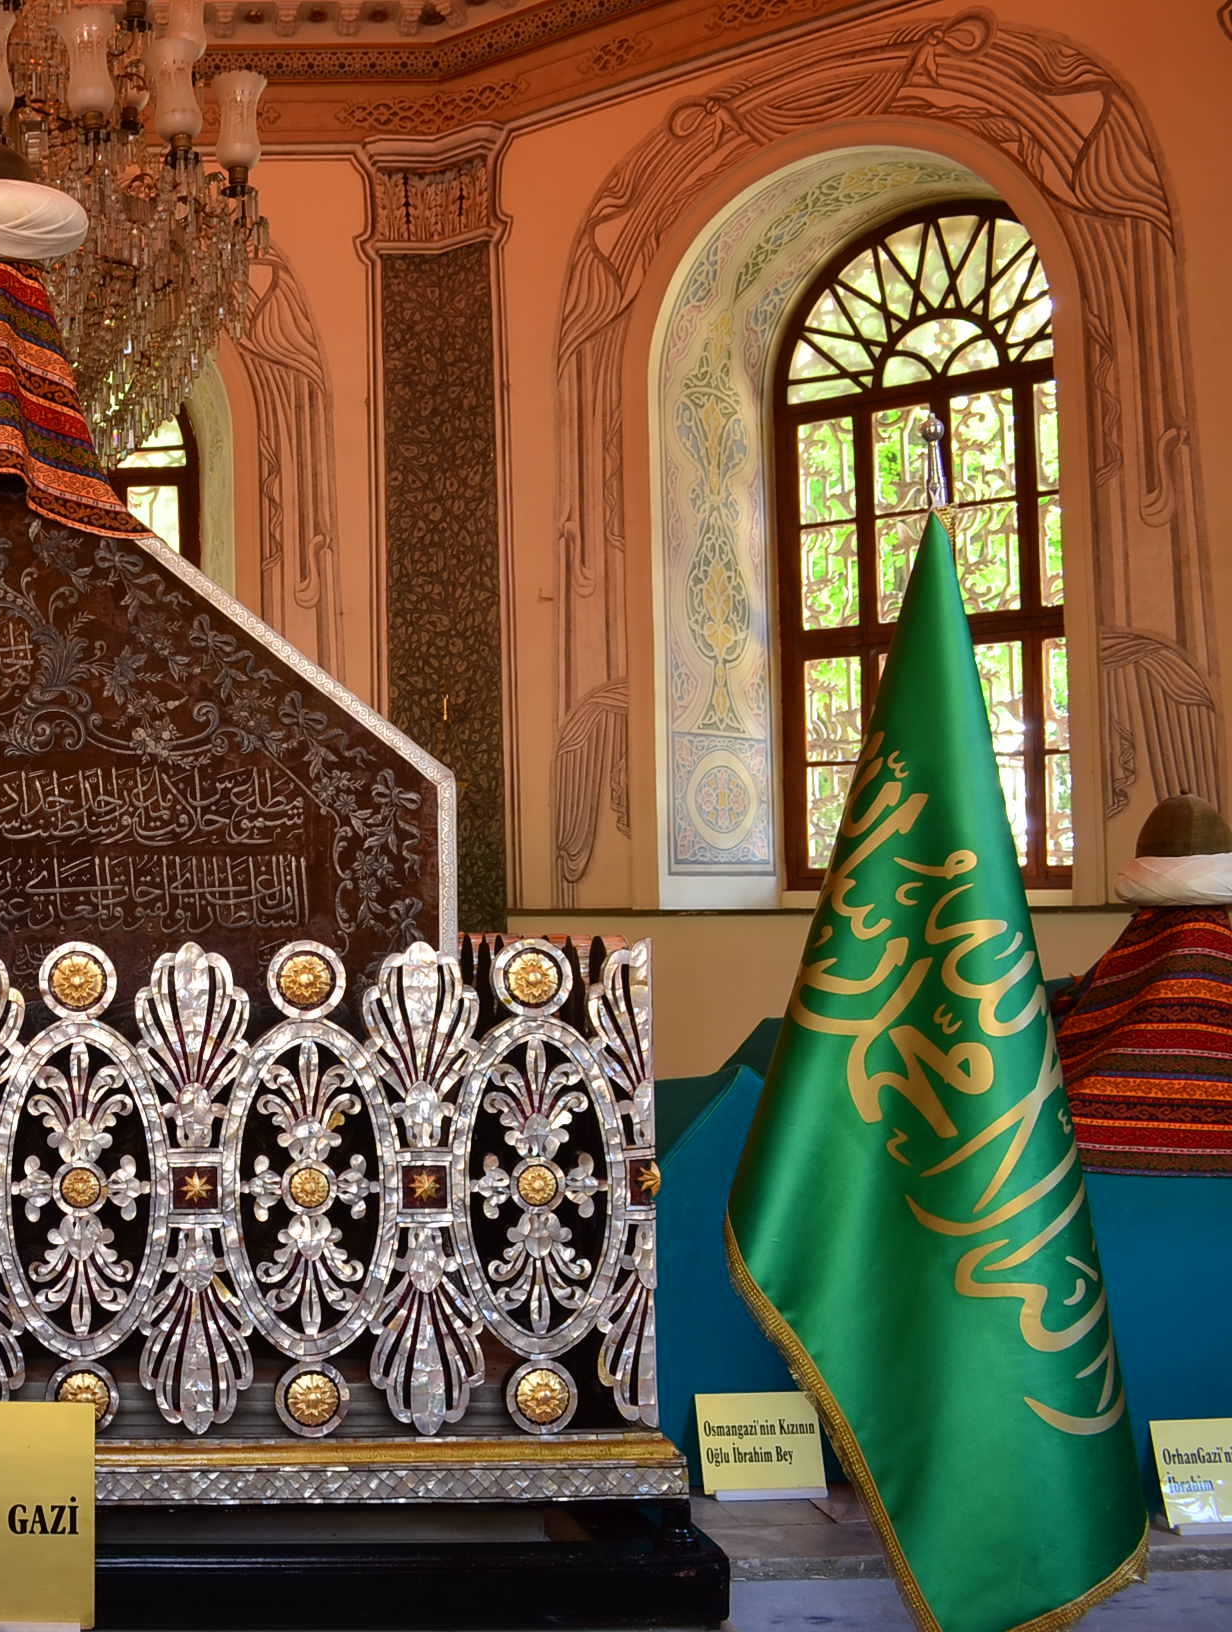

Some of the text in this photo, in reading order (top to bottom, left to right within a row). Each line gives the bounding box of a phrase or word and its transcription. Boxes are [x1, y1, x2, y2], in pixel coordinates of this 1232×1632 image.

[777, 1418, 816, 1435] Kızının
[706, 1442, 794, 1468] Oğlu İbrahim Bey
[8, 1496, 79, 1535] GAZİ
